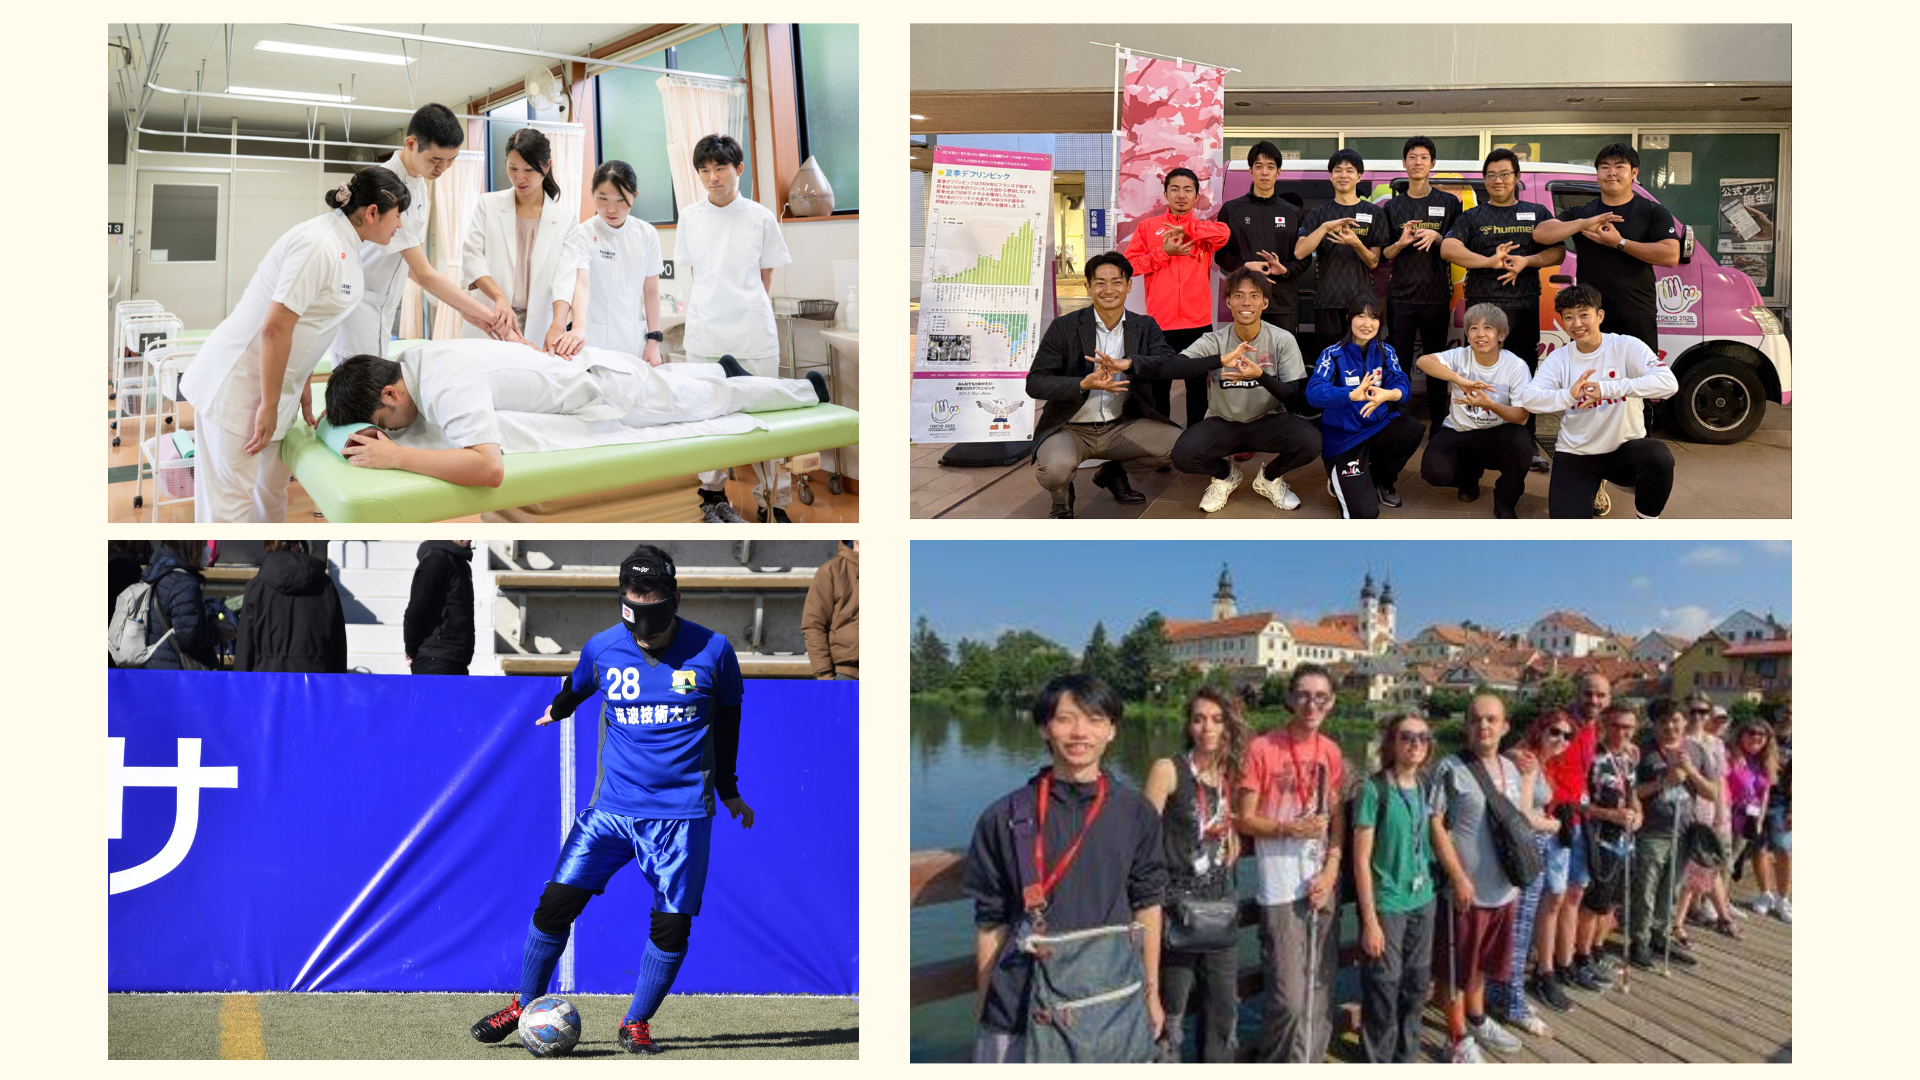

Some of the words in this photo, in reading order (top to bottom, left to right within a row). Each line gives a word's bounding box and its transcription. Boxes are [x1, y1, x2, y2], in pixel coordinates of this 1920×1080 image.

[945, 169, 1011, 180] 夏季デフリンピック
[1721, 184, 1773, 197] 公式アプリ
[108, 224, 122, 233] 13
[1493, 224, 1535, 234] hummel
[660, 263, 673, 276] 0
[606, 667, 640, 700] 28
[614, 704, 697, 725] 筑波技術大学
